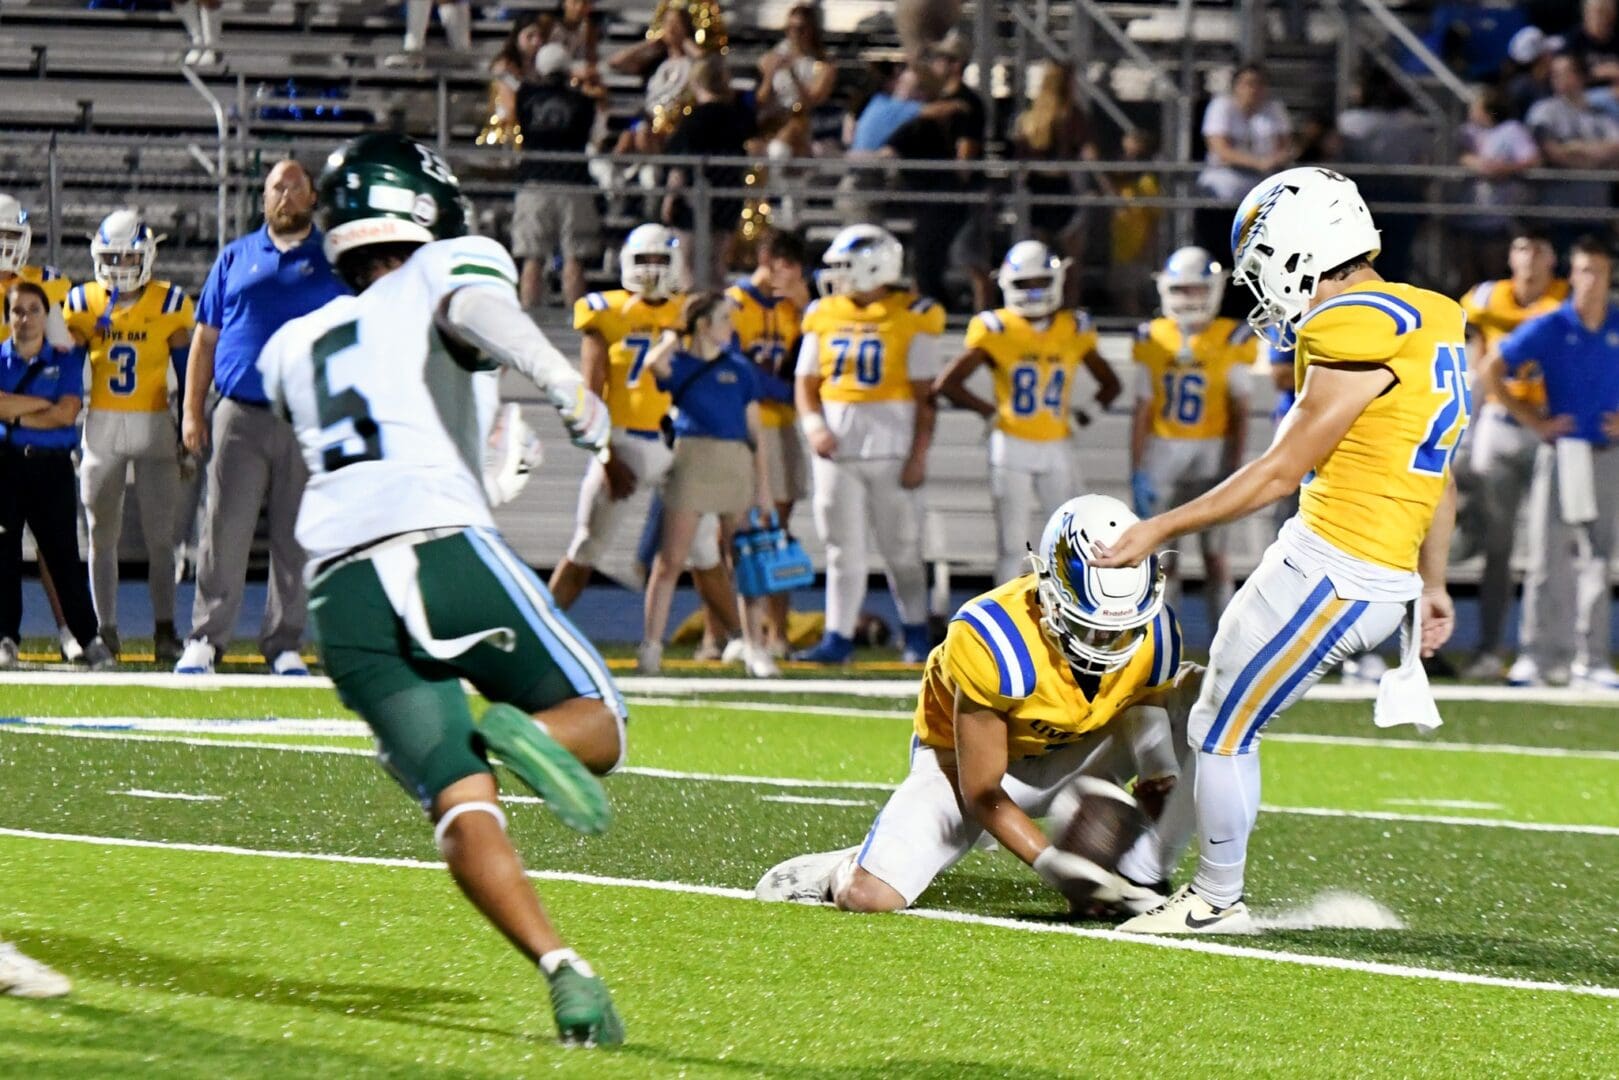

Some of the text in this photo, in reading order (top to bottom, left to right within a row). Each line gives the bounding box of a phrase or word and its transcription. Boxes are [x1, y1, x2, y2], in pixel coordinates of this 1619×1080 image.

[108, 343, 138, 395] 3
[830, 337, 883, 387] 70
[311, 318, 384, 473] 5
[1012, 365, 1066, 418] 84
[1162, 372, 1206, 424] 16
